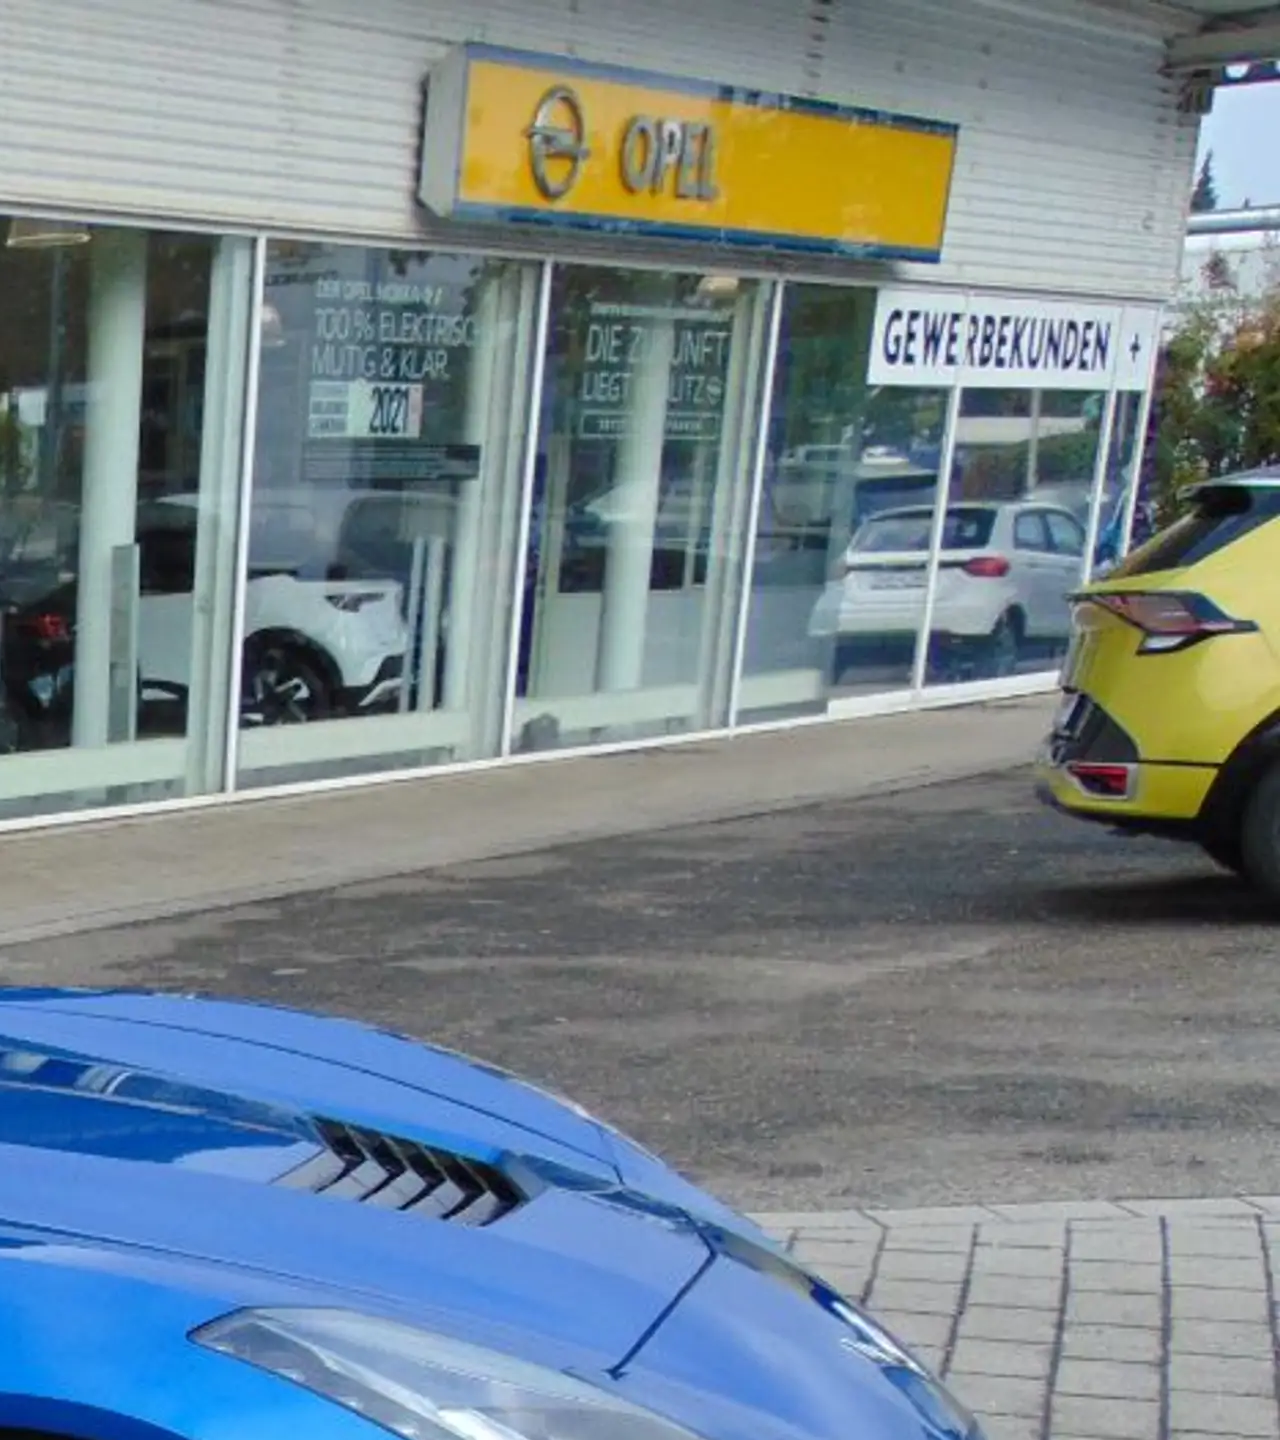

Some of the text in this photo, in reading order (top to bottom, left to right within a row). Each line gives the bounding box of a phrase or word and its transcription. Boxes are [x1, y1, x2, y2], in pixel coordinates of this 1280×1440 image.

[620, 114, 718, 200] OPEL
[585, 324, 623, 362] DIE
[883, 309, 1111, 371] GEWERBEKUNDEN
[380, 349, 396, 377] &
[399, 350, 449, 380] KLAR
[369, 387, 409, 434] 2021
